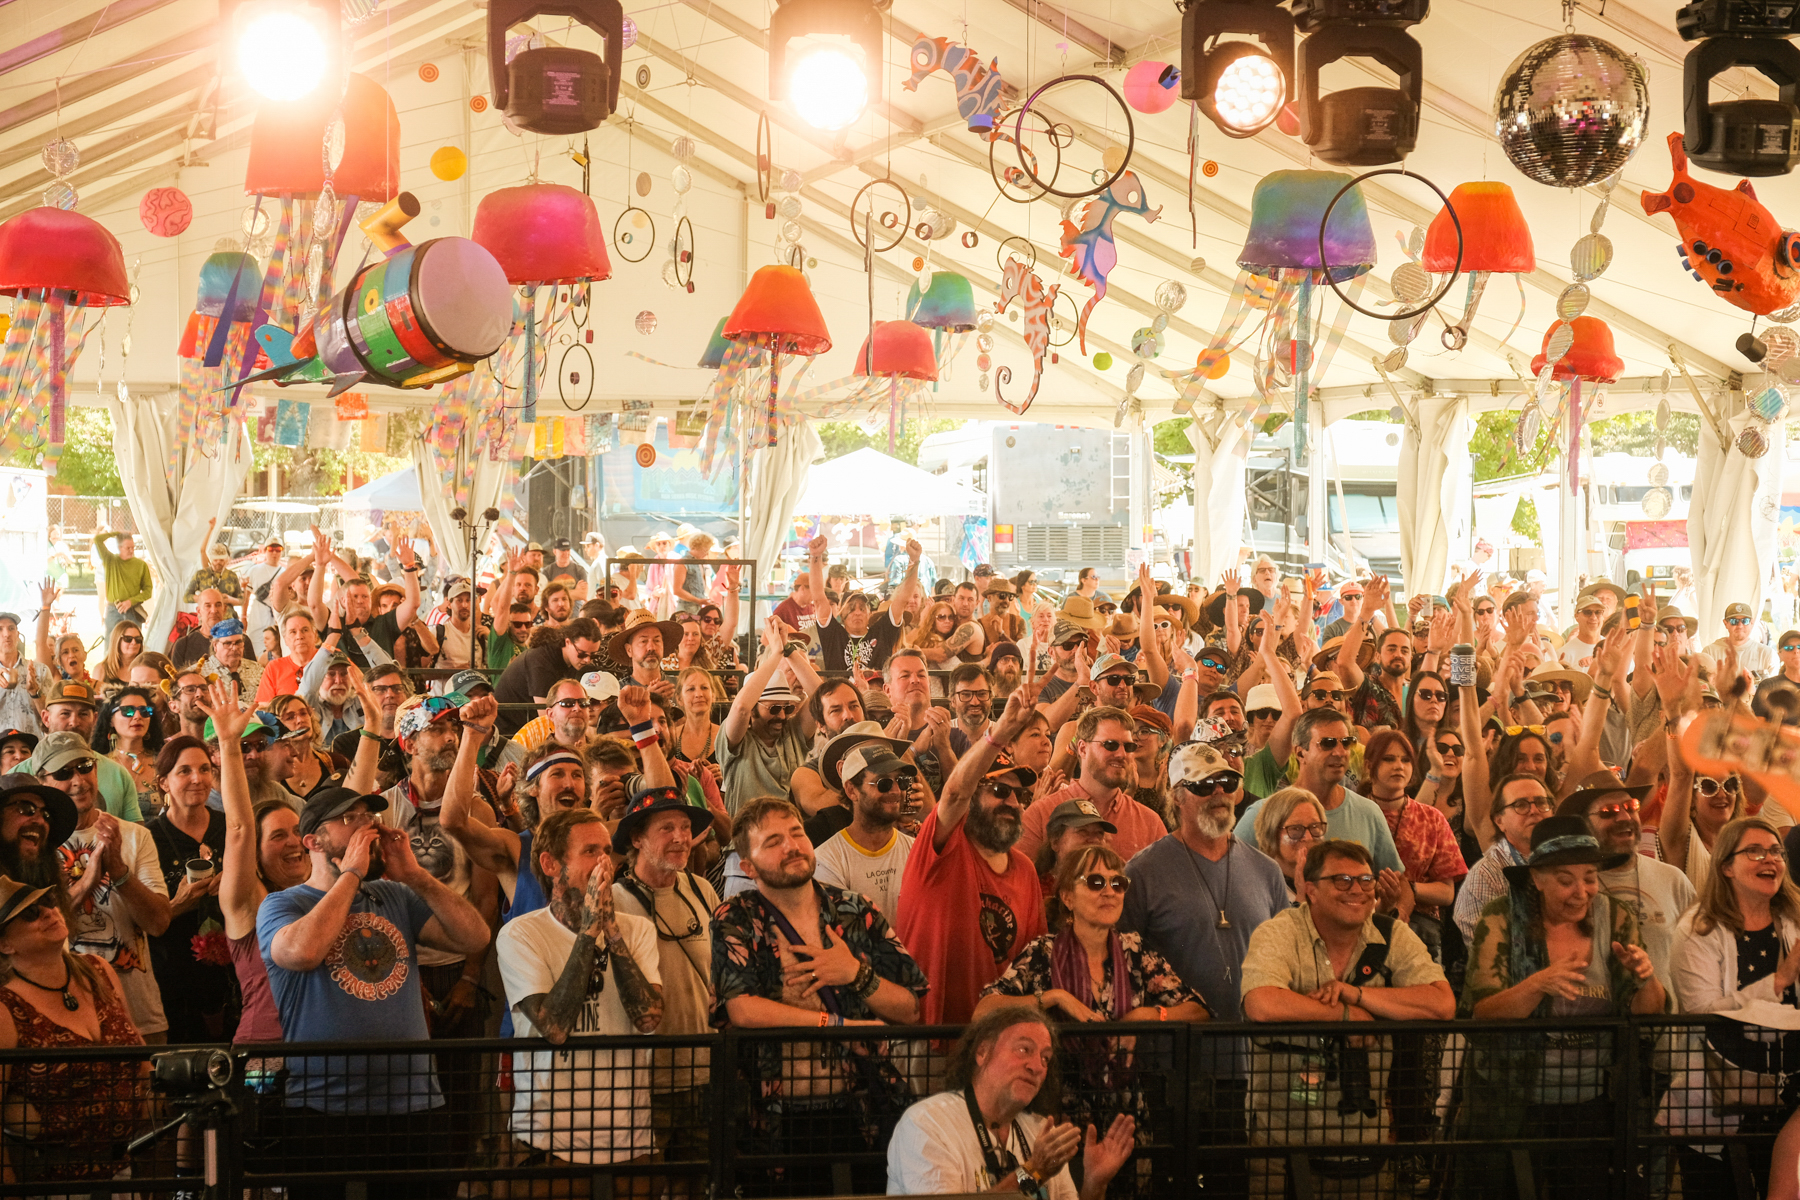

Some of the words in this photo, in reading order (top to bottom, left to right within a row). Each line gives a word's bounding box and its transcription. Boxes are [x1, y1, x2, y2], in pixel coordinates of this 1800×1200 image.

[866, 871, 875, 879] LA
[875, 867, 897, 877] County
[977, 1123, 989, 1148] Canon
